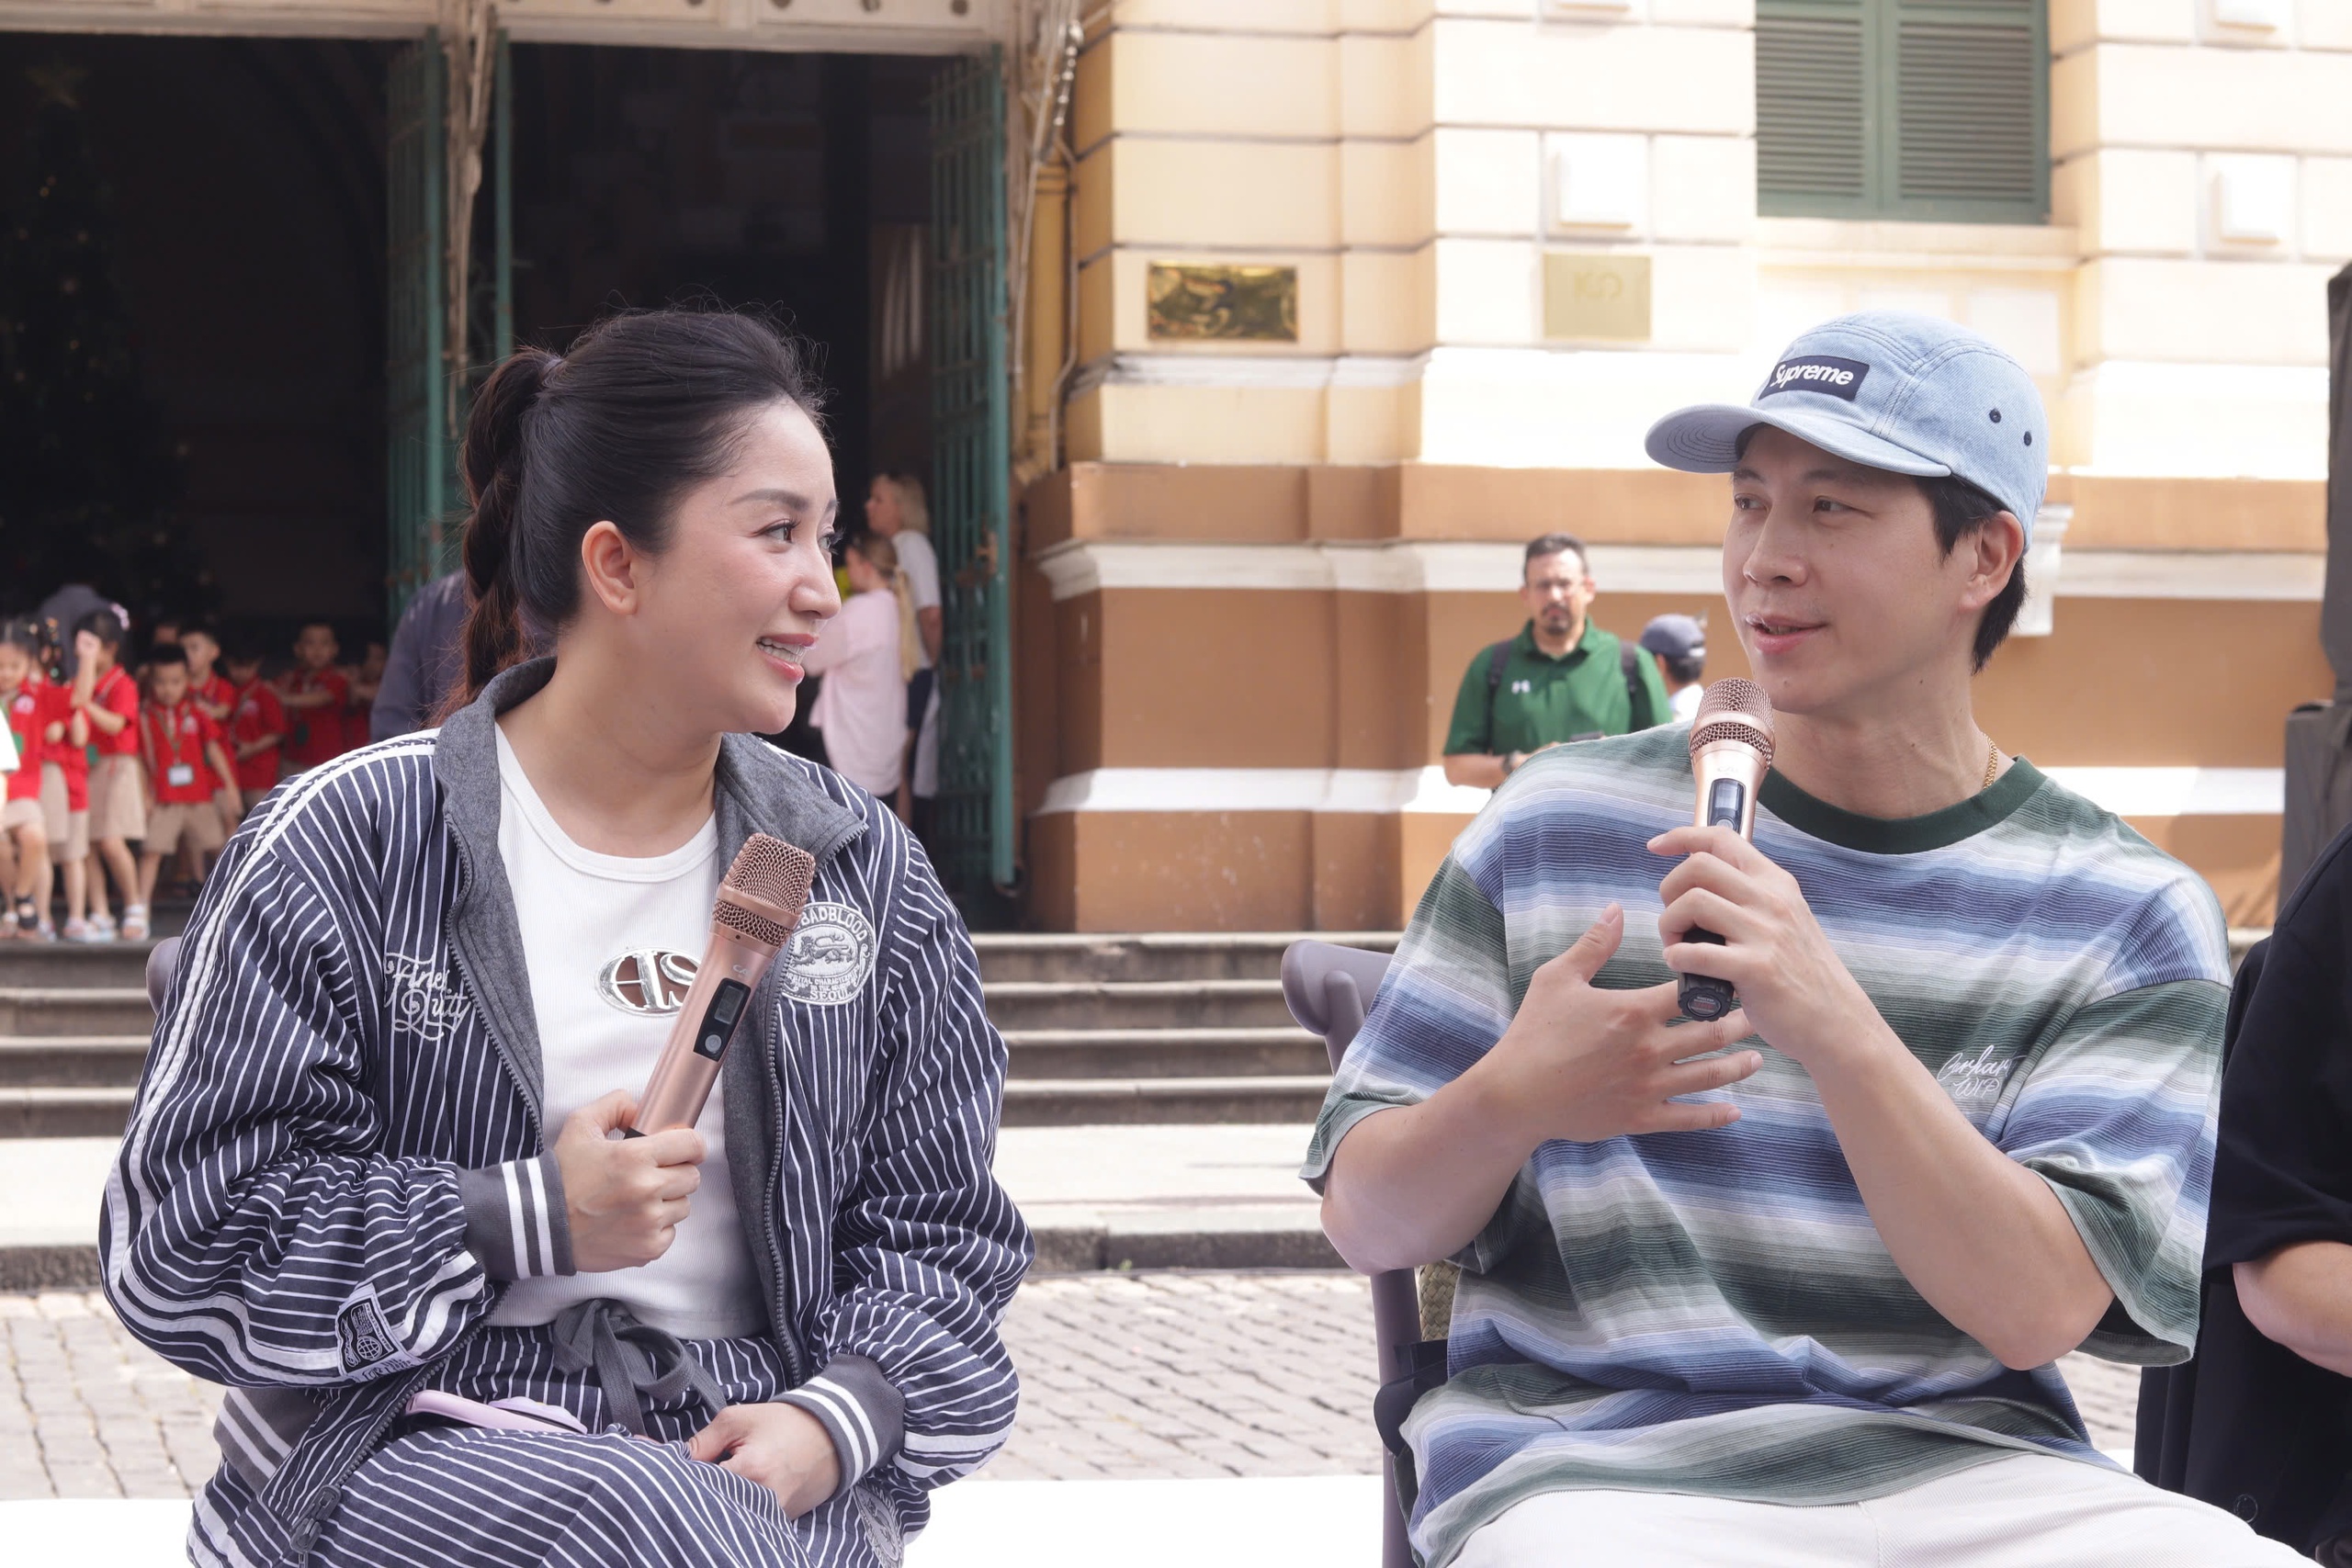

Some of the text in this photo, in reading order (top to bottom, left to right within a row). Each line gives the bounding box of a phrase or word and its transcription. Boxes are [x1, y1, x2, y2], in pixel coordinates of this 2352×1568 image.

[1770, 363, 1854, 389] Supreme
[800, 906, 867, 942] BADBLOOD
[1952, 1077, 2000, 1099] WIP
